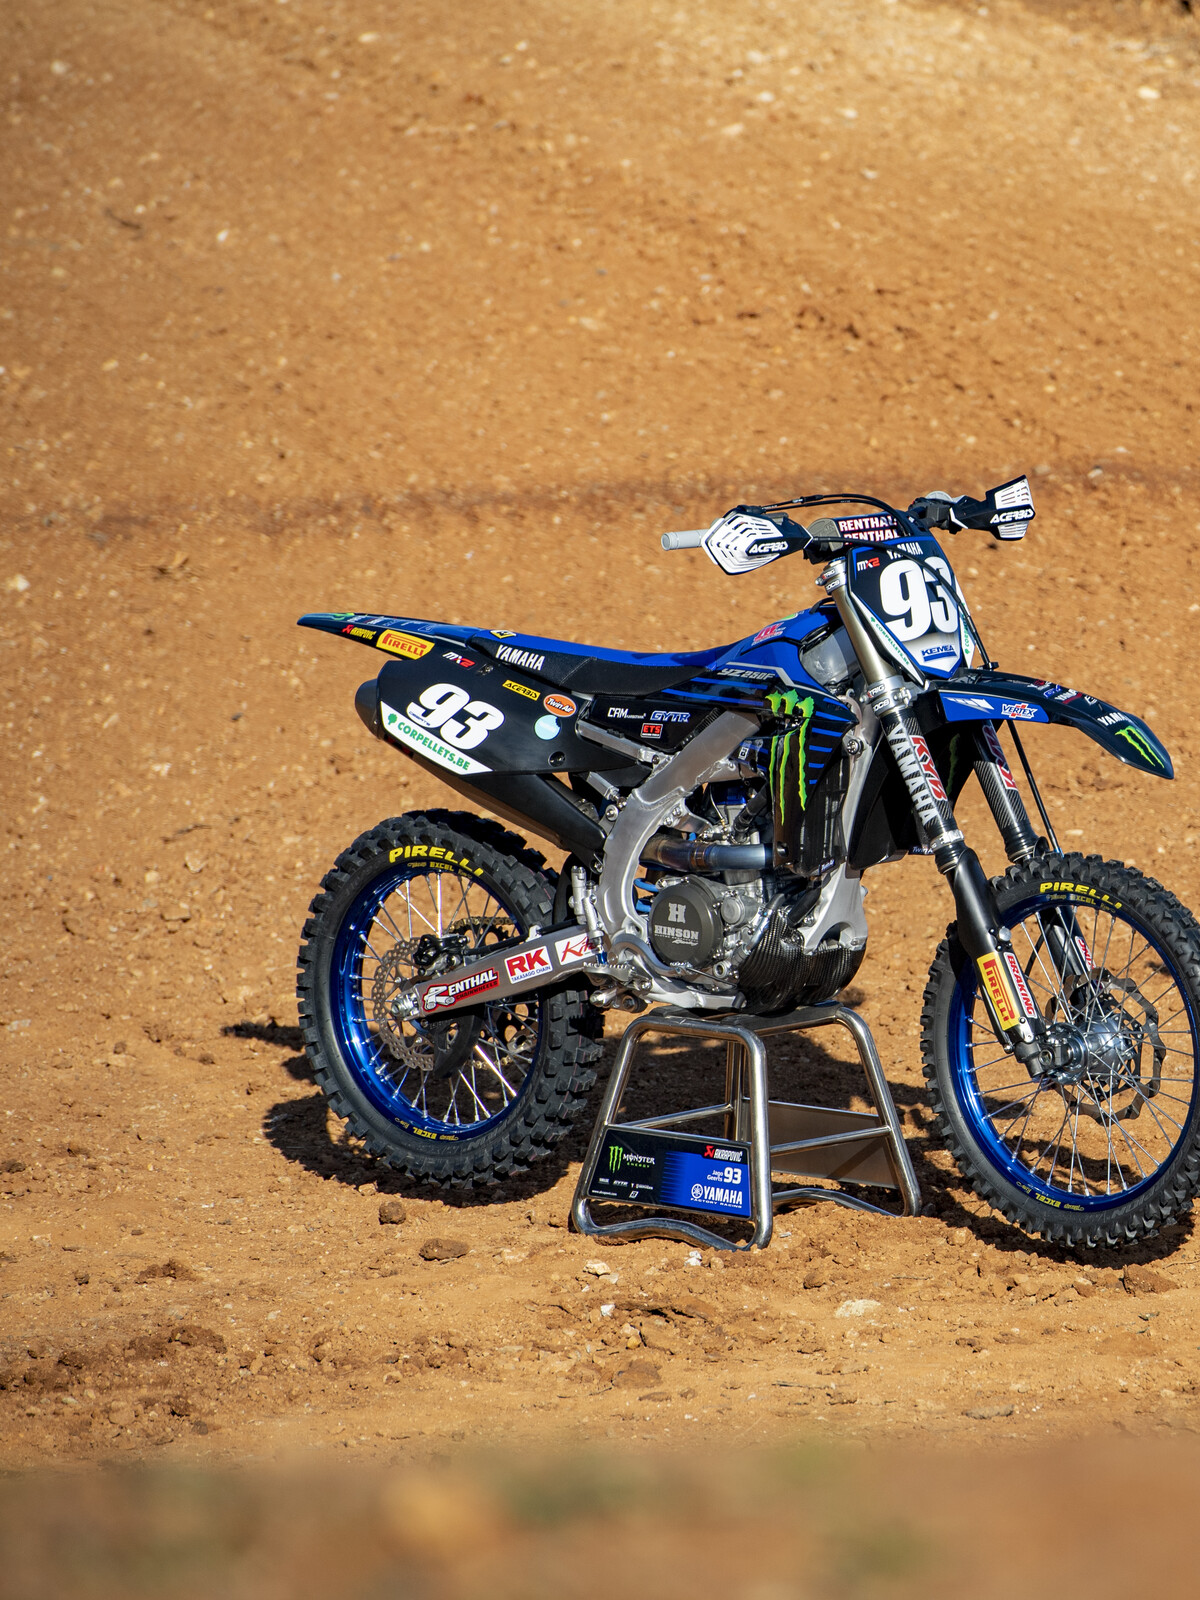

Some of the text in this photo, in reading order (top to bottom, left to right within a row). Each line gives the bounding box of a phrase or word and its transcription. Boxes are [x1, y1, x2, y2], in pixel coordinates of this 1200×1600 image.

[838, 515, 896, 532] RENTHAL
[880, 556, 959, 642] 93
[382, 633, 428, 657] PIRELLI
[495, 644, 545, 671] YAMAHA
[717, 668, 776, 680] YZ250F
[547, 698, 574, 714] Twin Air
[1002, 703, 1035, 717] VERTEX
[406, 683, 505, 750] 93
[650, 710, 690, 723] GYTR
[643, 725, 662, 734] ETS
[397, 721, 471, 771] CORPELLETS.BE
[886, 722, 938, 827] YAMAHA
[909, 734, 948, 801] KYB
[389, 845, 484, 877] PIRELLI
[429, 861, 454, 872] EXCEL
[1040, 882, 1123, 909] PIRELLI
[1070, 894, 1096, 905] EXCEL
[654, 925, 699, 940] HINSON
[506, 948, 549, 977] RK
[536, 965, 551, 975] CHAIN
[983, 959, 1015, 1022] PIRELLI
[1007, 955, 1036, 1015] BRAKING
[412, 1126, 437, 1140] EXCEL
[623, 1153, 655, 1165] MONSTER
[707, 1174, 723, 1182] Geerts
[712, 1169, 723, 1177] Jago
[724, 1166, 742, 1185] 93
[704, 1185, 743, 1205] YAMAHA
[1035, 1192, 1061, 1208] EXCEL
